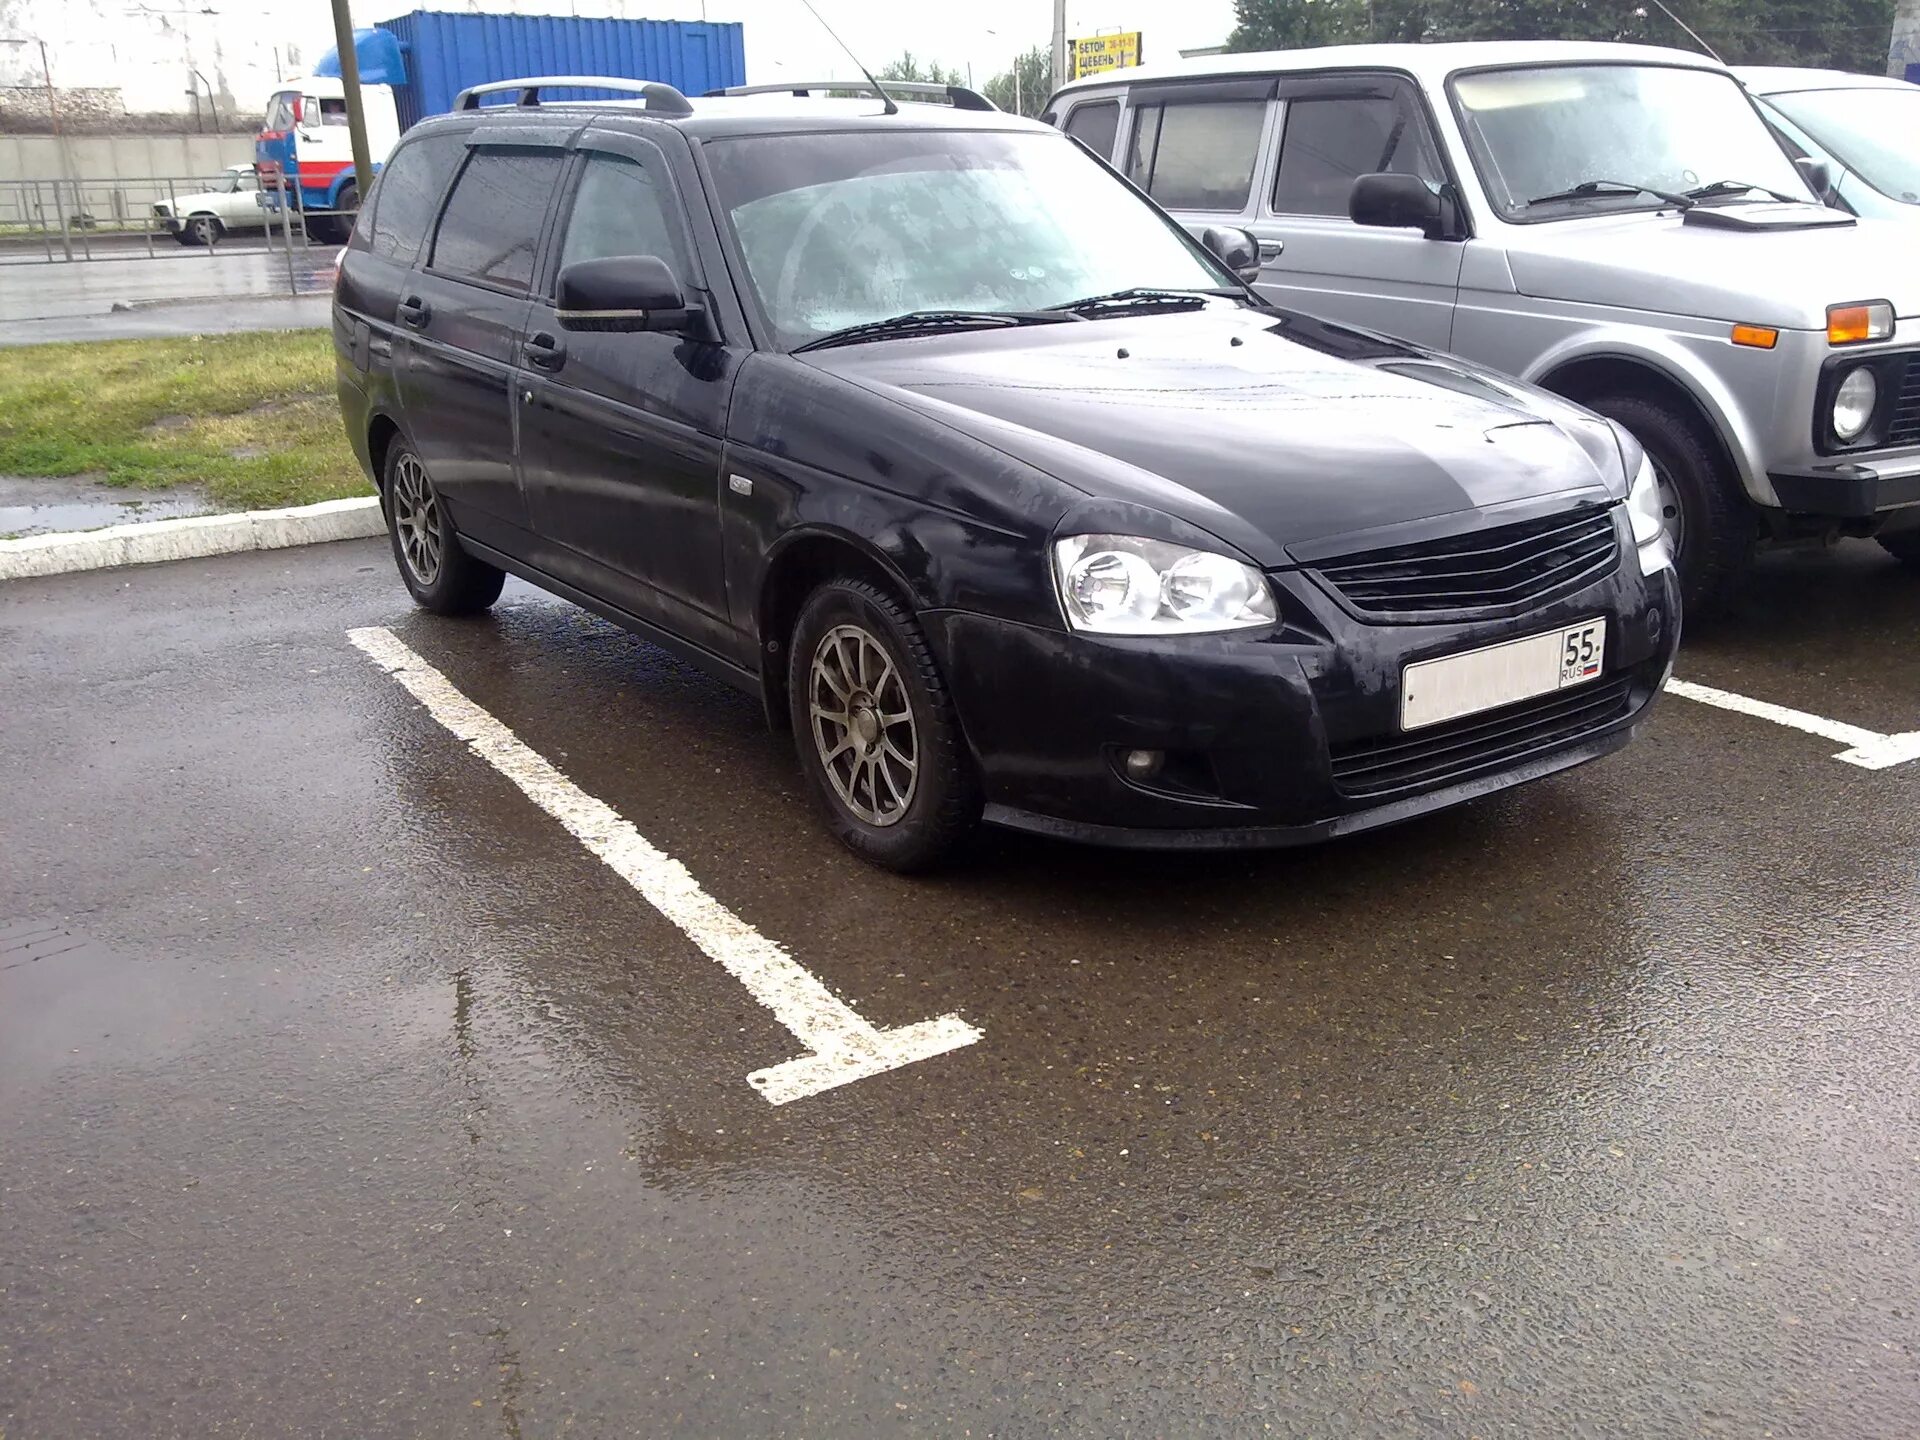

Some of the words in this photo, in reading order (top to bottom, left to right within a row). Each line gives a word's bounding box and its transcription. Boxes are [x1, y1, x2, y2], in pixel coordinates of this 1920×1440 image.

[1079, 41, 1105, 53] БЕТОН
[1080, 54, 1114, 69] ЩЕБЕНЬ
[1565, 628, 1595, 666] 55
[1561, 665, 1583, 681] RUS
